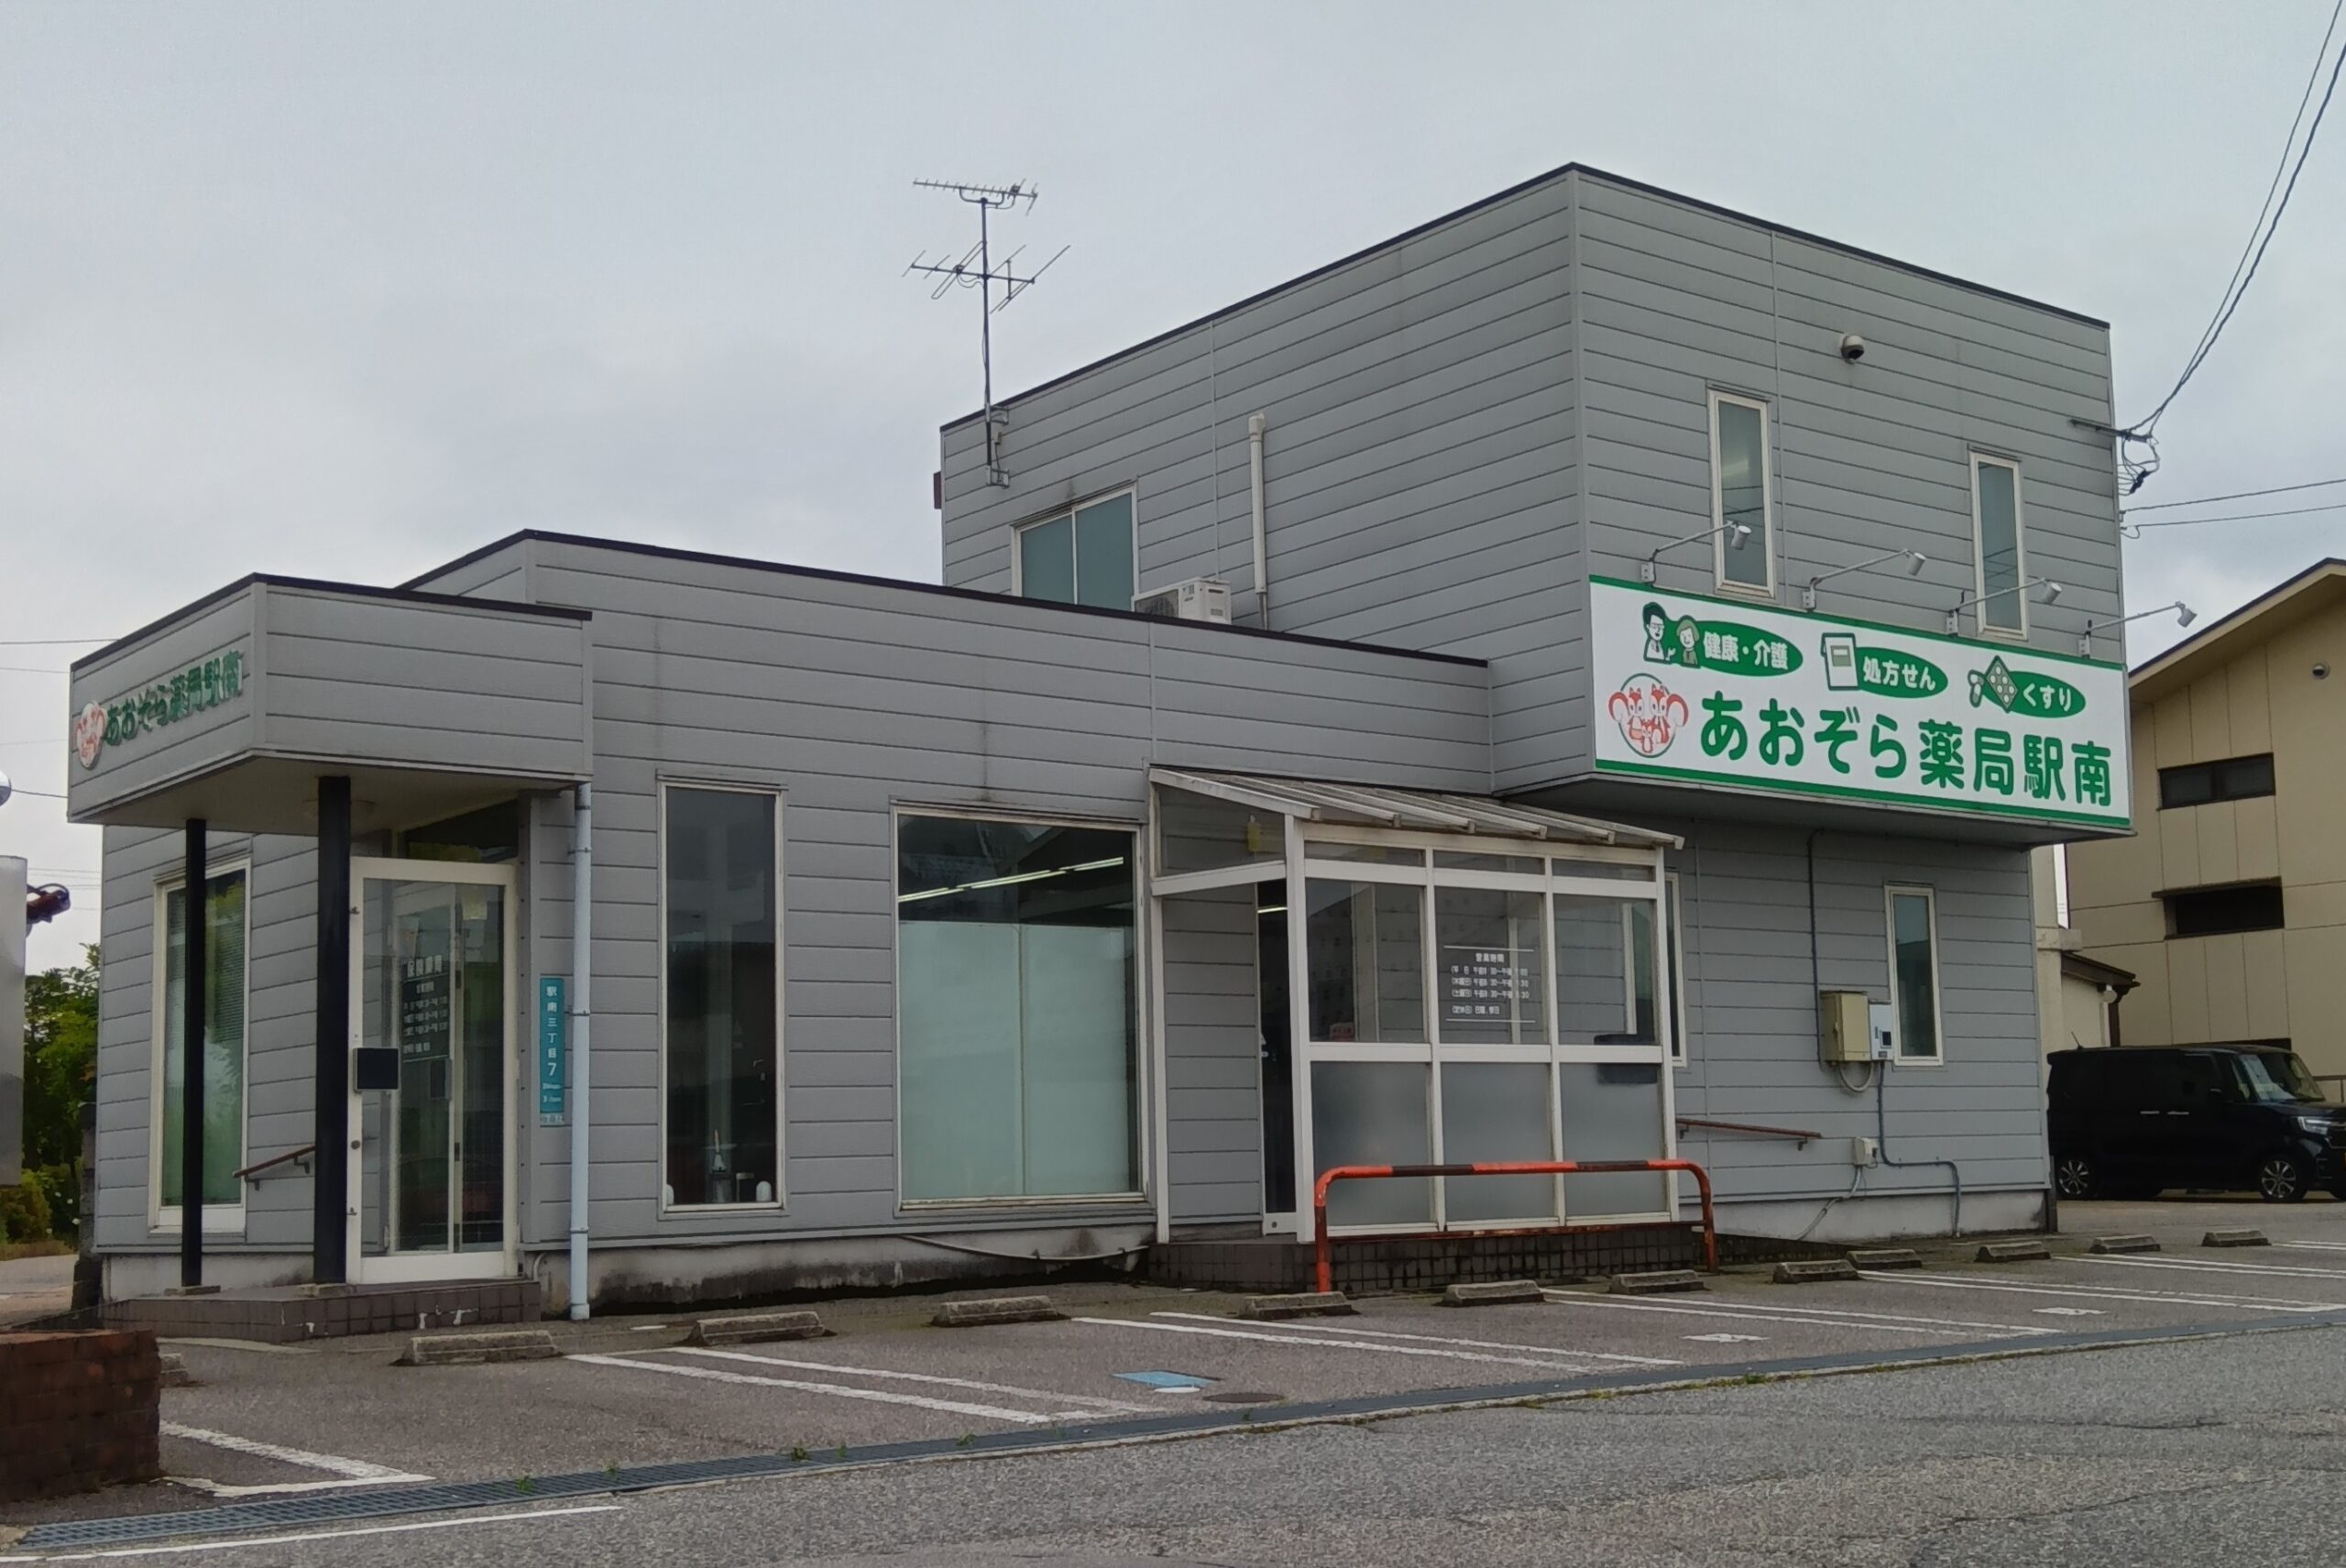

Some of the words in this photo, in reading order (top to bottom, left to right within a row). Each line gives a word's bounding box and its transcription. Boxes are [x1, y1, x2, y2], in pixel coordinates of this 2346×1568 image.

[1703, 630, 1790, 671] 健康・介護
[1862, 655, 1936, 692] 処方せん
[2023, 682, 2073, 711] くすり
[1700, 690, 2111, 806] あおぞら薬局駅南
